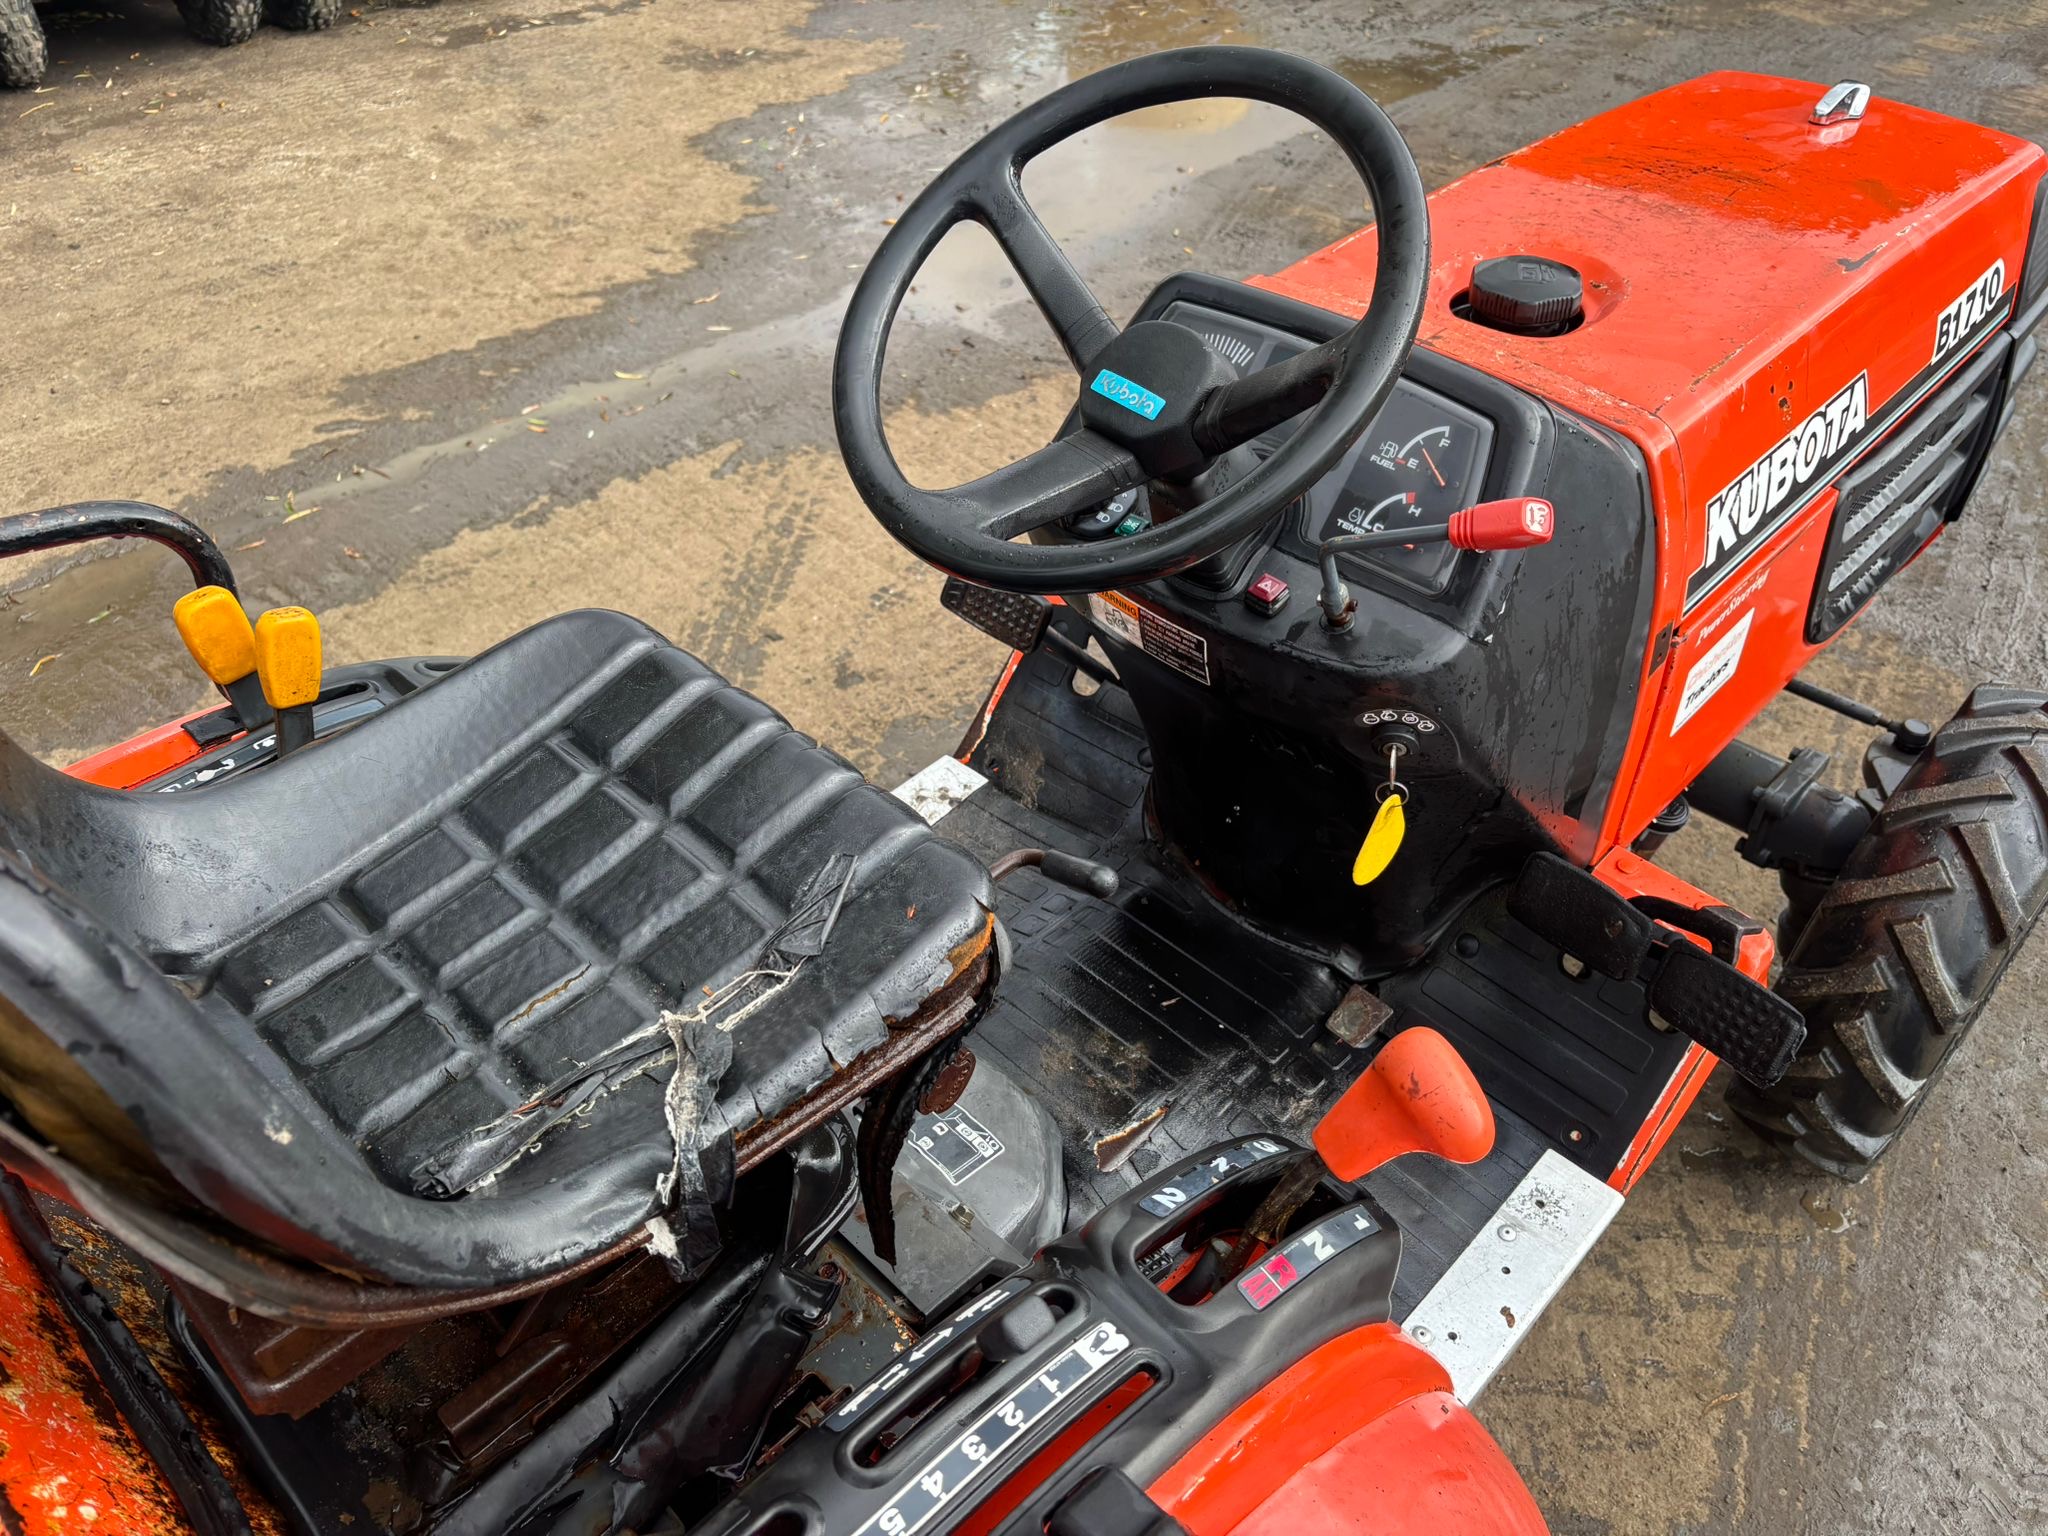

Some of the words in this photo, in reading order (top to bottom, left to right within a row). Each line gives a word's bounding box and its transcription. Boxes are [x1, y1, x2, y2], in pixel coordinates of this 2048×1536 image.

[1935, 265, 2002, 358] B1710
[1100, 374, 1155, 415] Kubota
[1439, 438, 1450, 447] F
[1369, 454, 1396, 470] FUEL
[1407, 458, 1419, 469] E
[1705, 376, 1867, 568] KUBOTA
[1408, 505, 1422, 517] H
[1336, 518, 1366, 535] TEMP
[1101, 592, 1137, 616] ARNING
[1151, 1187, 1187, 1209] 2
[1301, 1230, 1336, 1261] N
[1264, 1253, 1297, 1289] R
[998, 1400, 1024, 1426] 2
[961, 1434, 987, 1460] 3
[921, 1470, 944, 1498] 4
